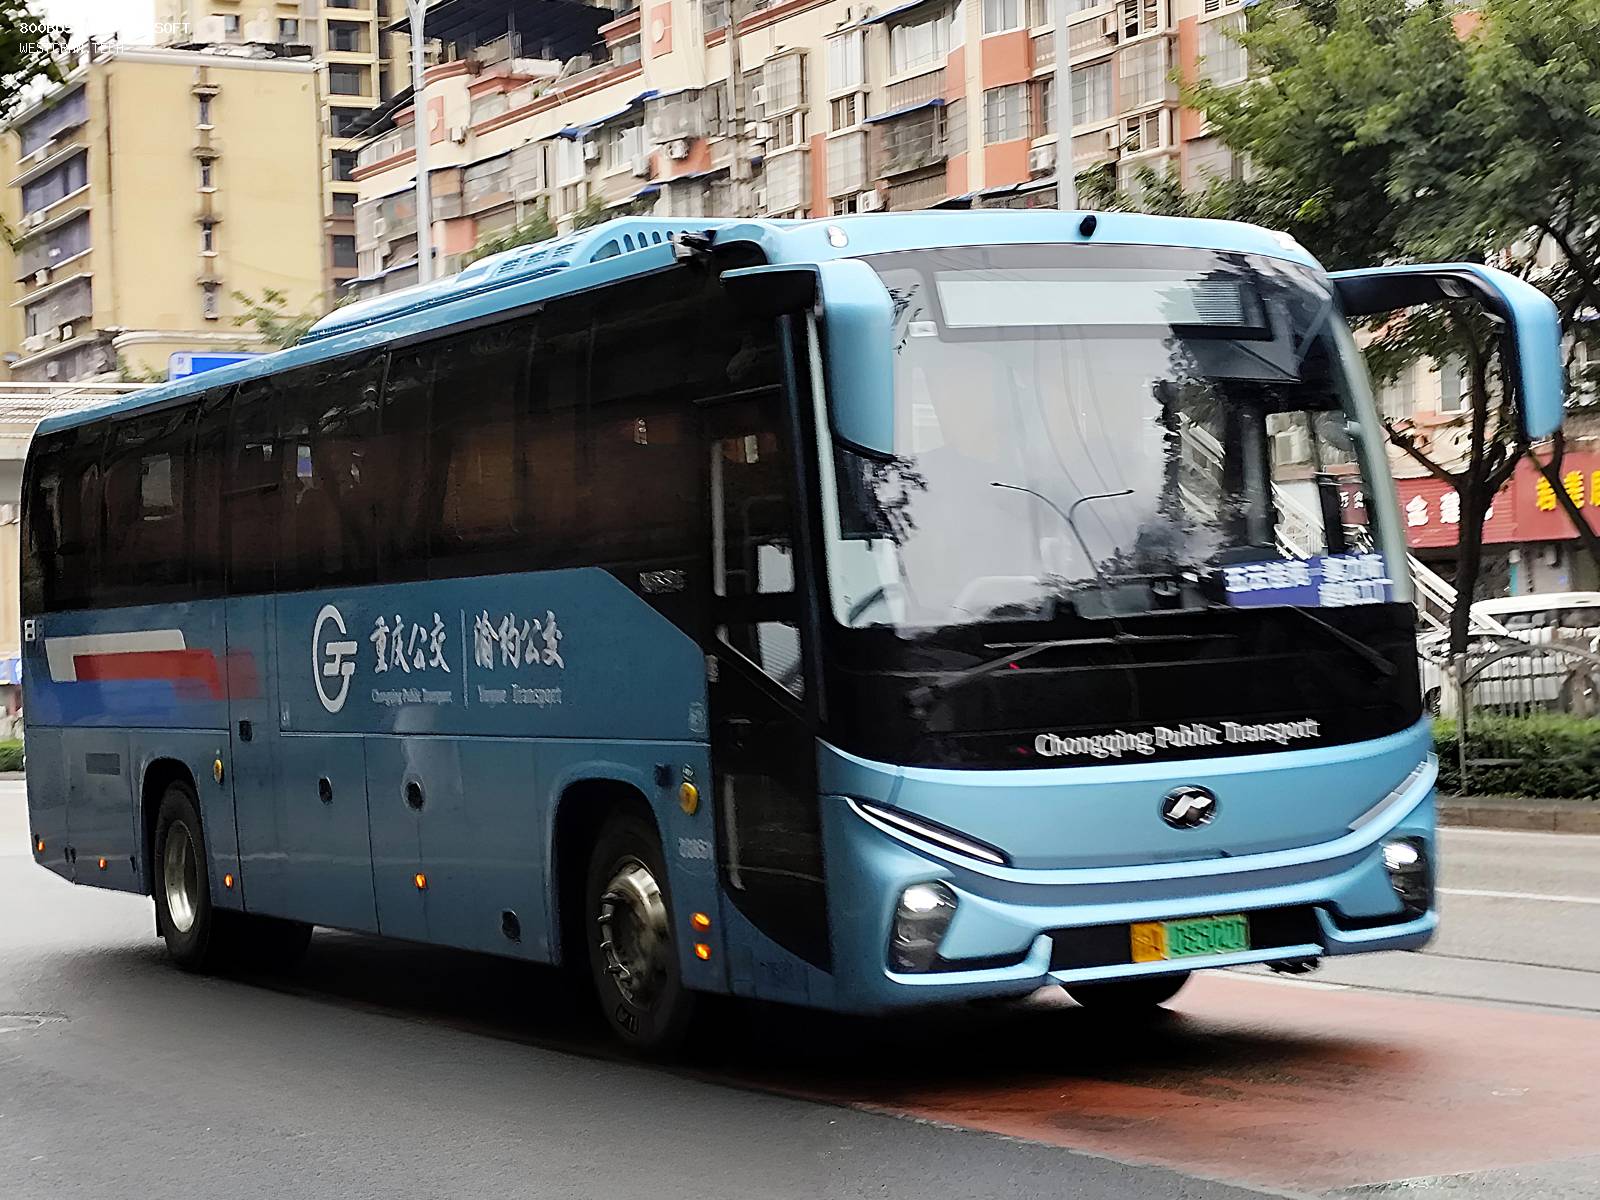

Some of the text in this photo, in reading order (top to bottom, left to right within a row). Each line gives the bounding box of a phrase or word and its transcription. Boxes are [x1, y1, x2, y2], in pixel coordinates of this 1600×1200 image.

[369, 611, 452, 674] 重庆公交
[1034, 717, 1321, 759] Chongqing Public Transport
